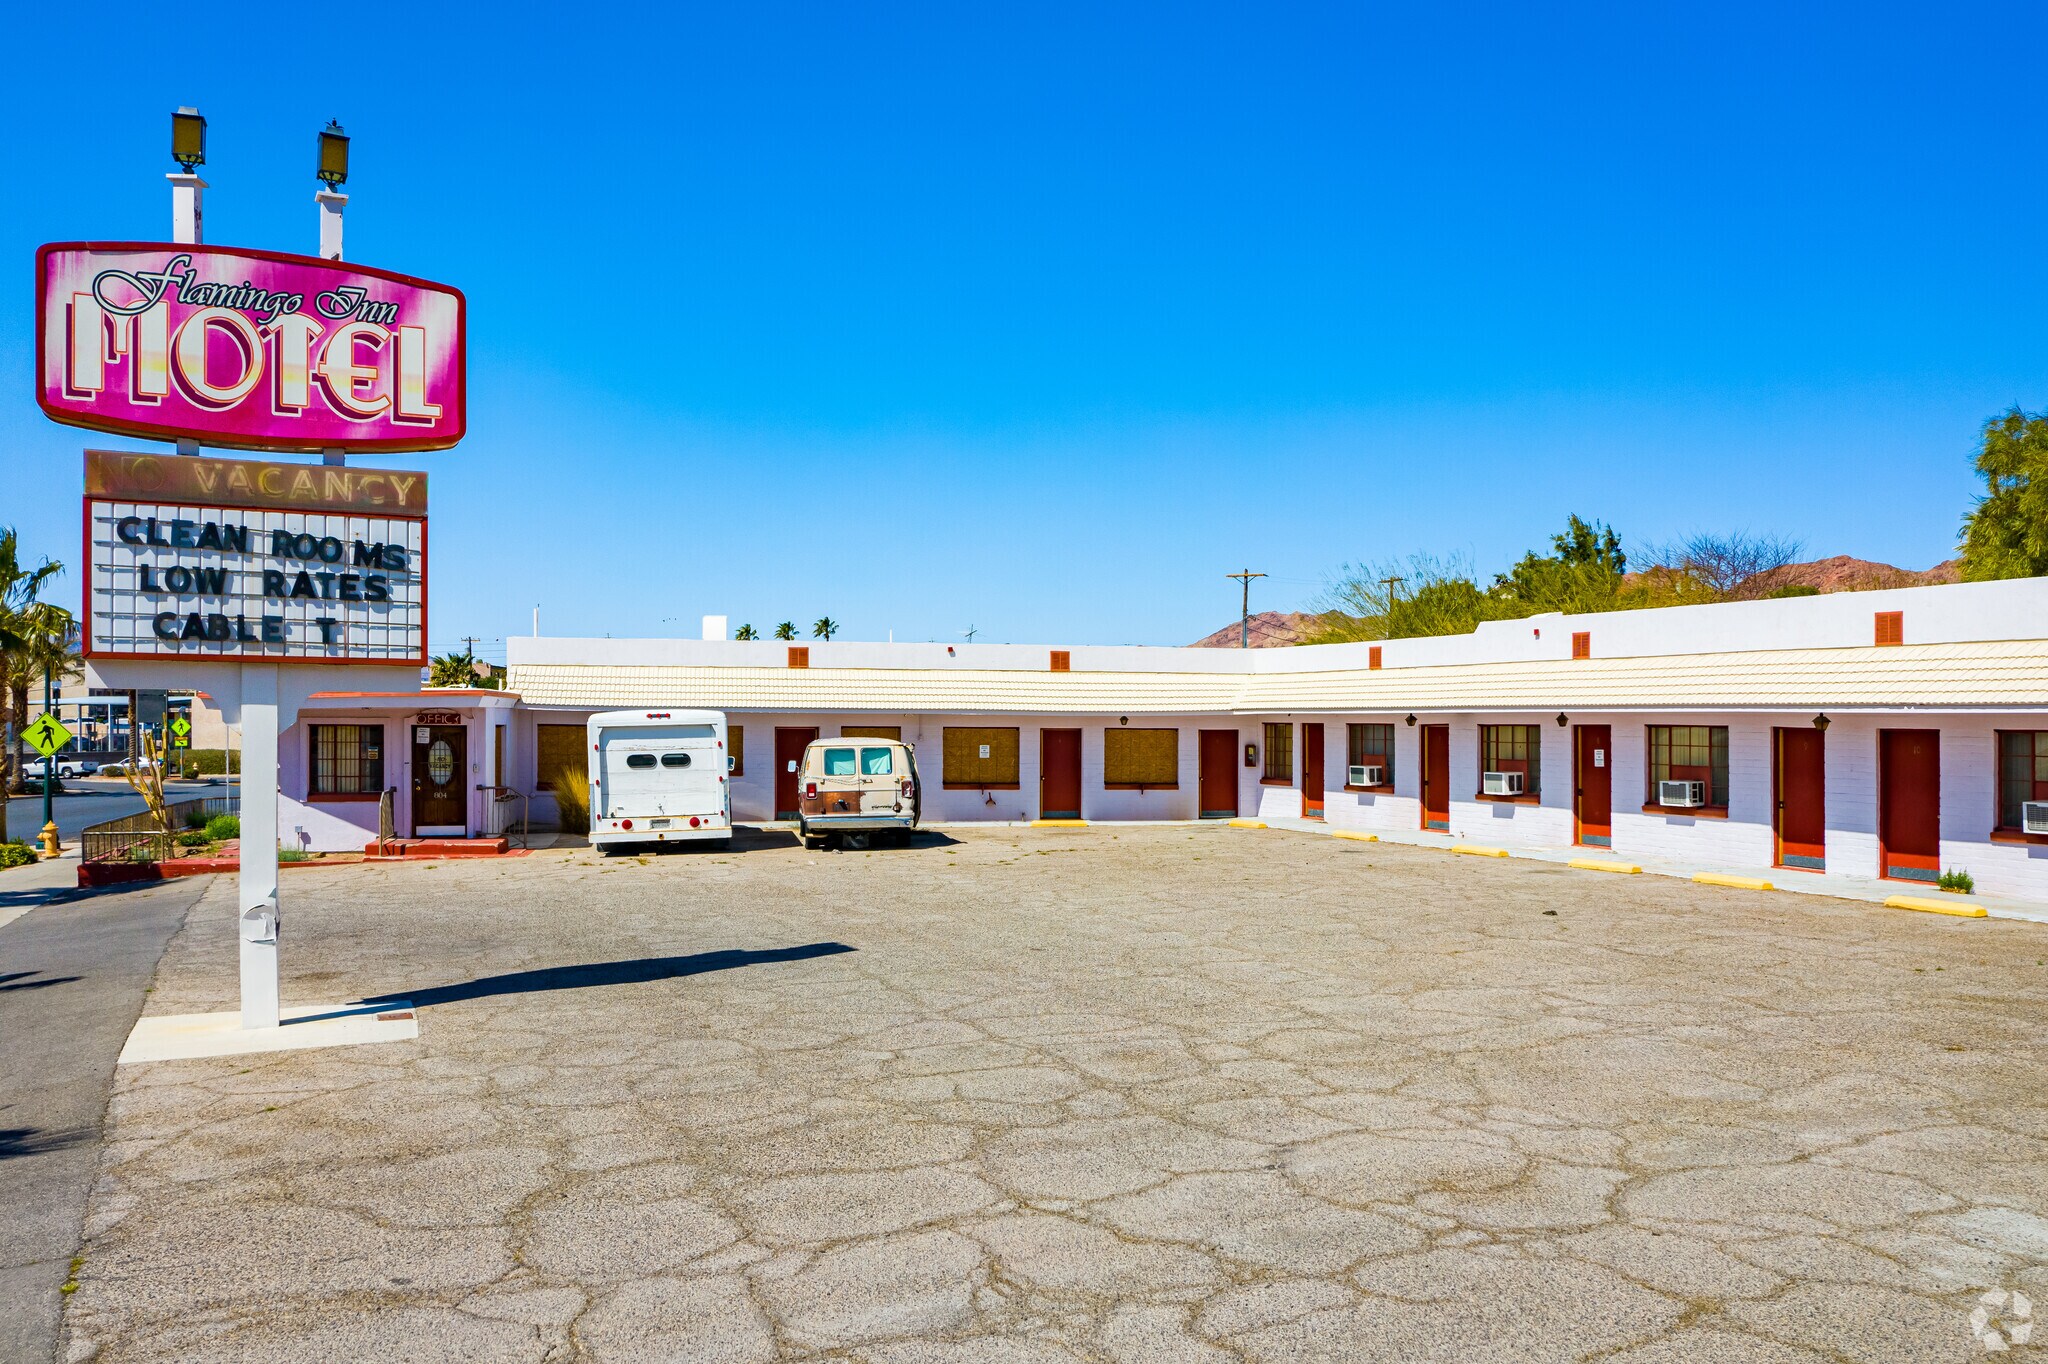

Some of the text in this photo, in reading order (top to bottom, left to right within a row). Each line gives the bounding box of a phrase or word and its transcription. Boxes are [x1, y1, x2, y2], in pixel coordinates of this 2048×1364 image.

[93, 254, 400, 325] Flamingo Inn
[62, 291, 442, 428] MOTEL
[193, 462, 417, 507] VACANCY
[116, 516, 249, 554] CLEAN
[139, 563, 388, 602] LOW RATES
[151, 611, 336, 645] CABLE T
